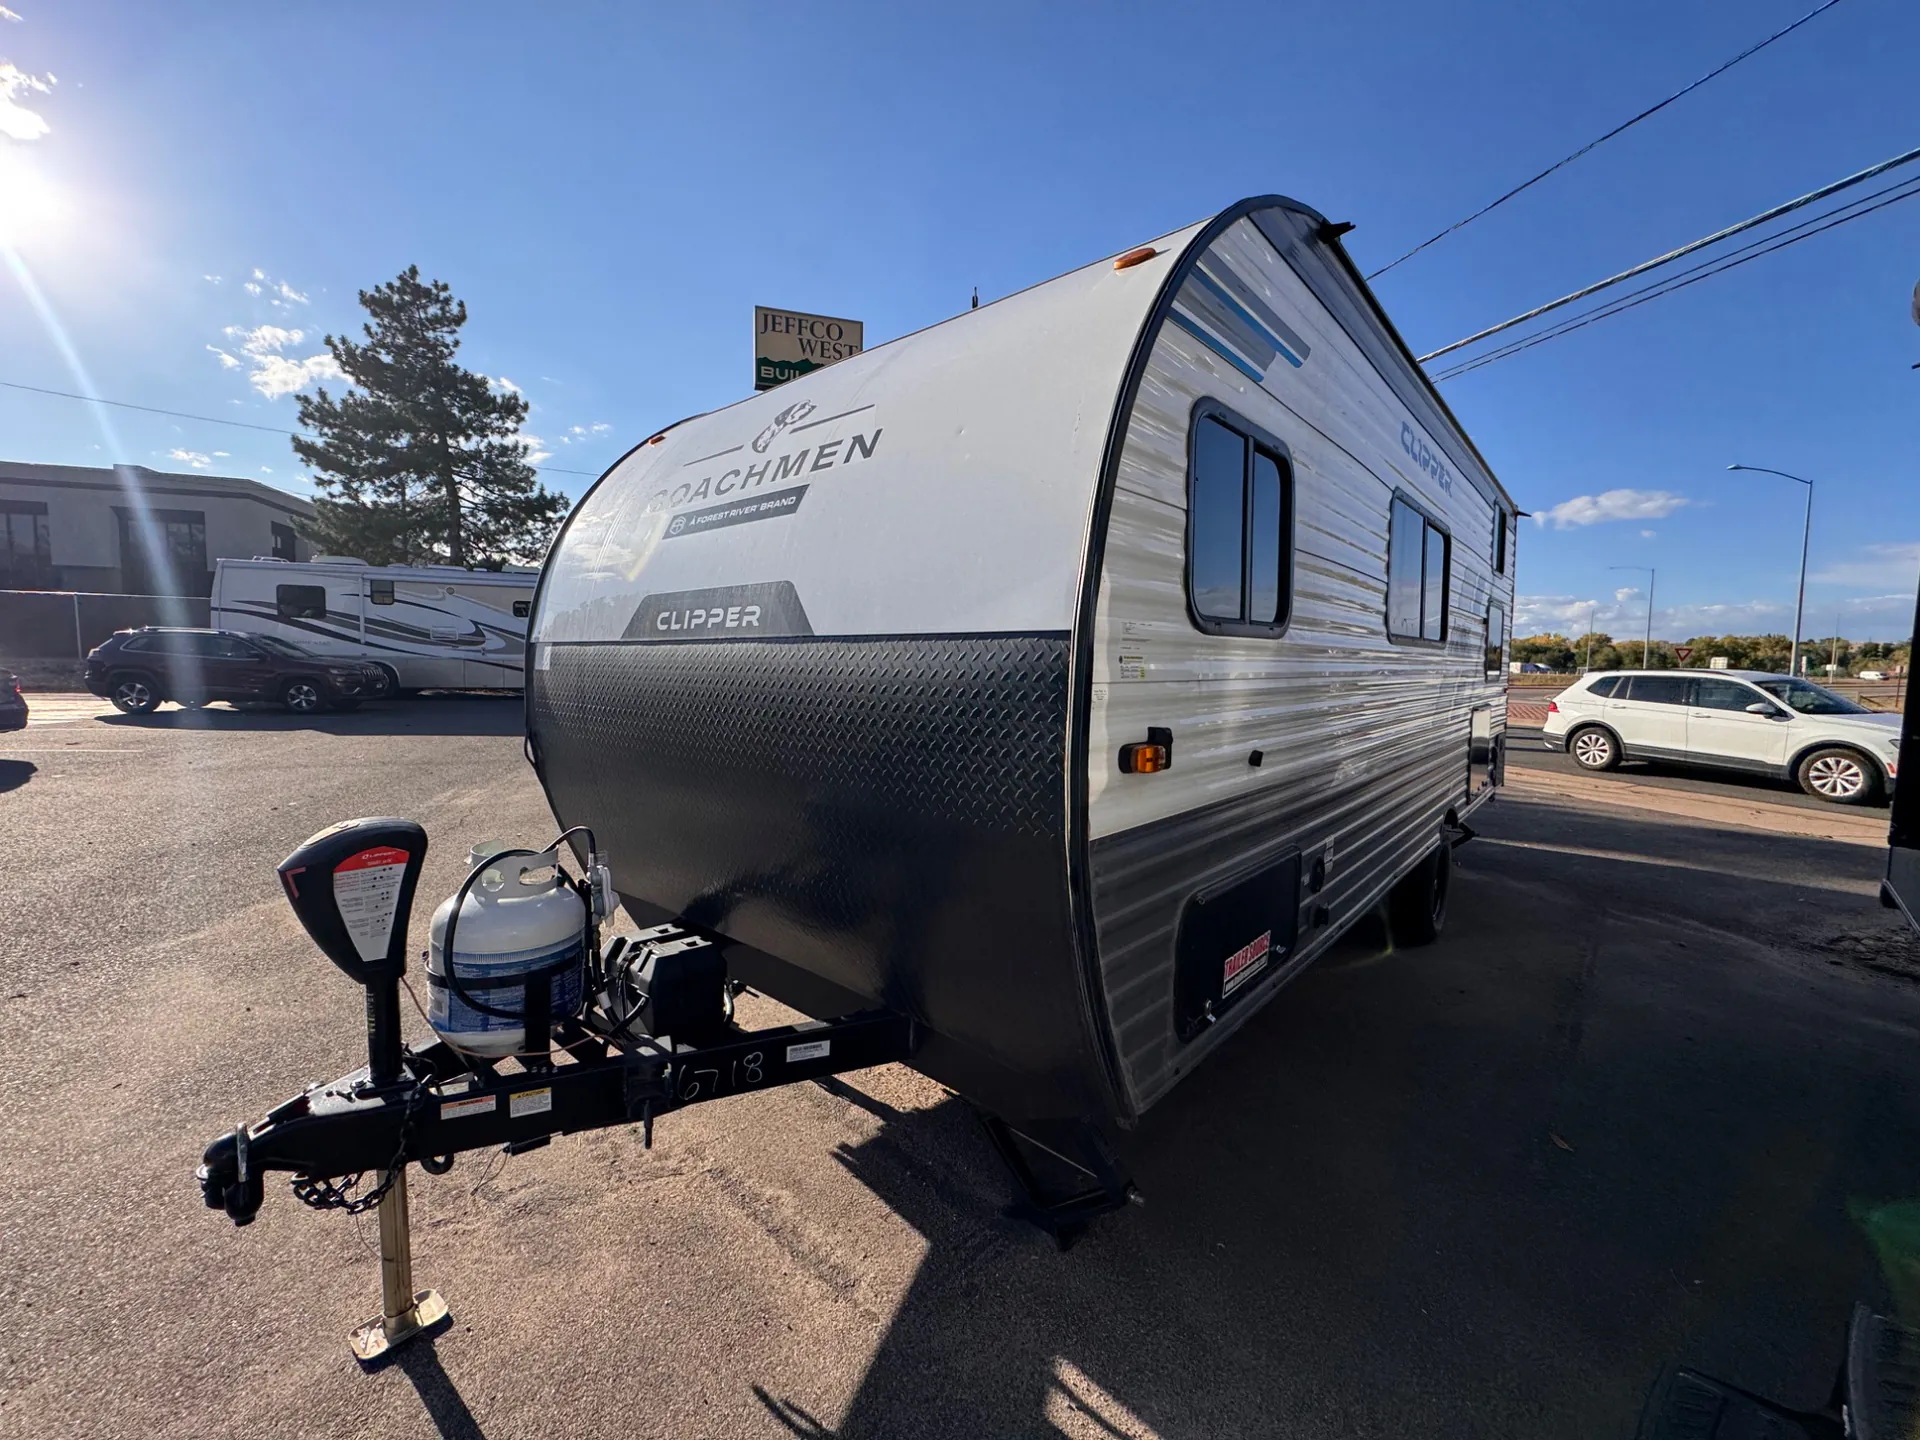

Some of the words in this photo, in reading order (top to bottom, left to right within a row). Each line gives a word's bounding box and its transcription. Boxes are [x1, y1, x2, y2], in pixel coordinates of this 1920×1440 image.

[760, 313, 843, 341] JEFFCO
[798, 338, 858, 361] WEST
[648, 428, 883, 512] COACHMEN
[1400, 421, 1453, 498] CLIPPER
[760, 496, 797, 511] BRAND
[656, 605, 761, 631] CLIPPER
[677, 1051, 764, 1100] 6718
